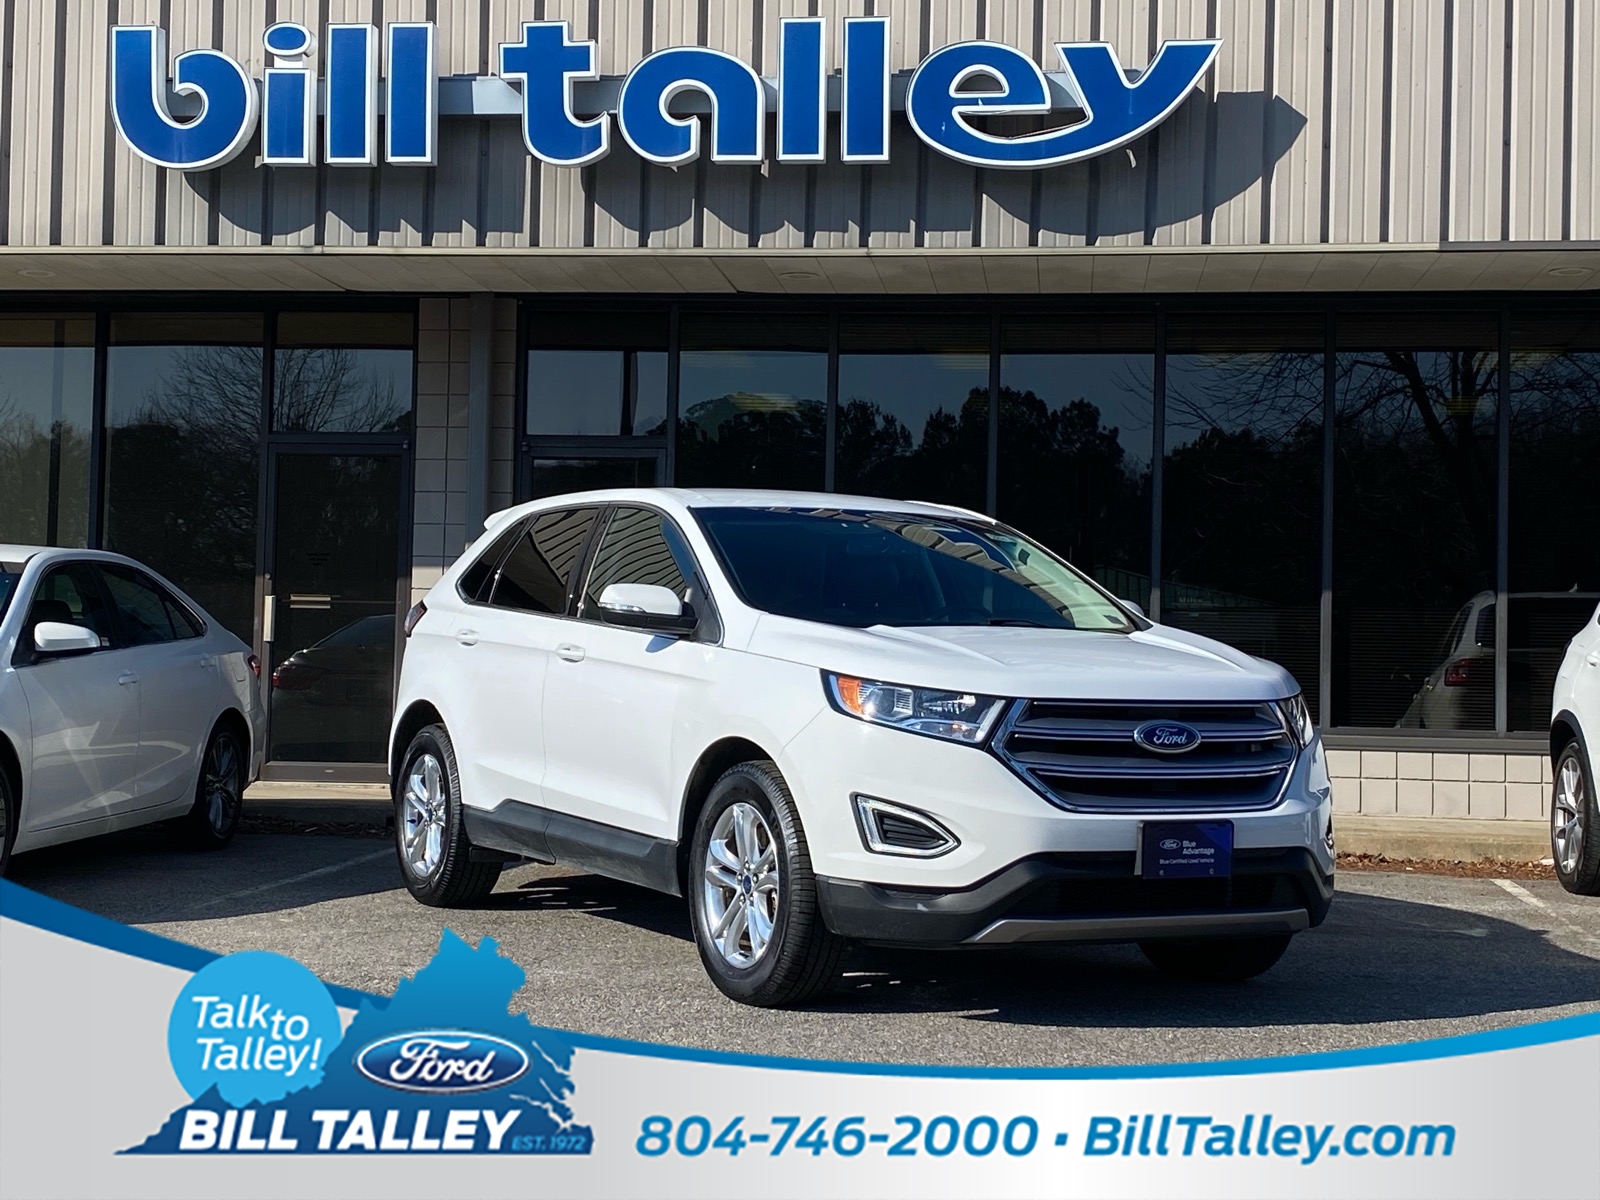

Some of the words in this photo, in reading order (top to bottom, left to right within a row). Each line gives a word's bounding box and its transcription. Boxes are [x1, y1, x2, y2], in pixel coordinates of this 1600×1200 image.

[110, 22, 438, 171] bill
[499, 16, 1223, 169] talley
[1153, 727, 1188, 745] Ford
[1182, 840, 1197, 848] Blue
[1182, 848, 1215, 856] Advantage
